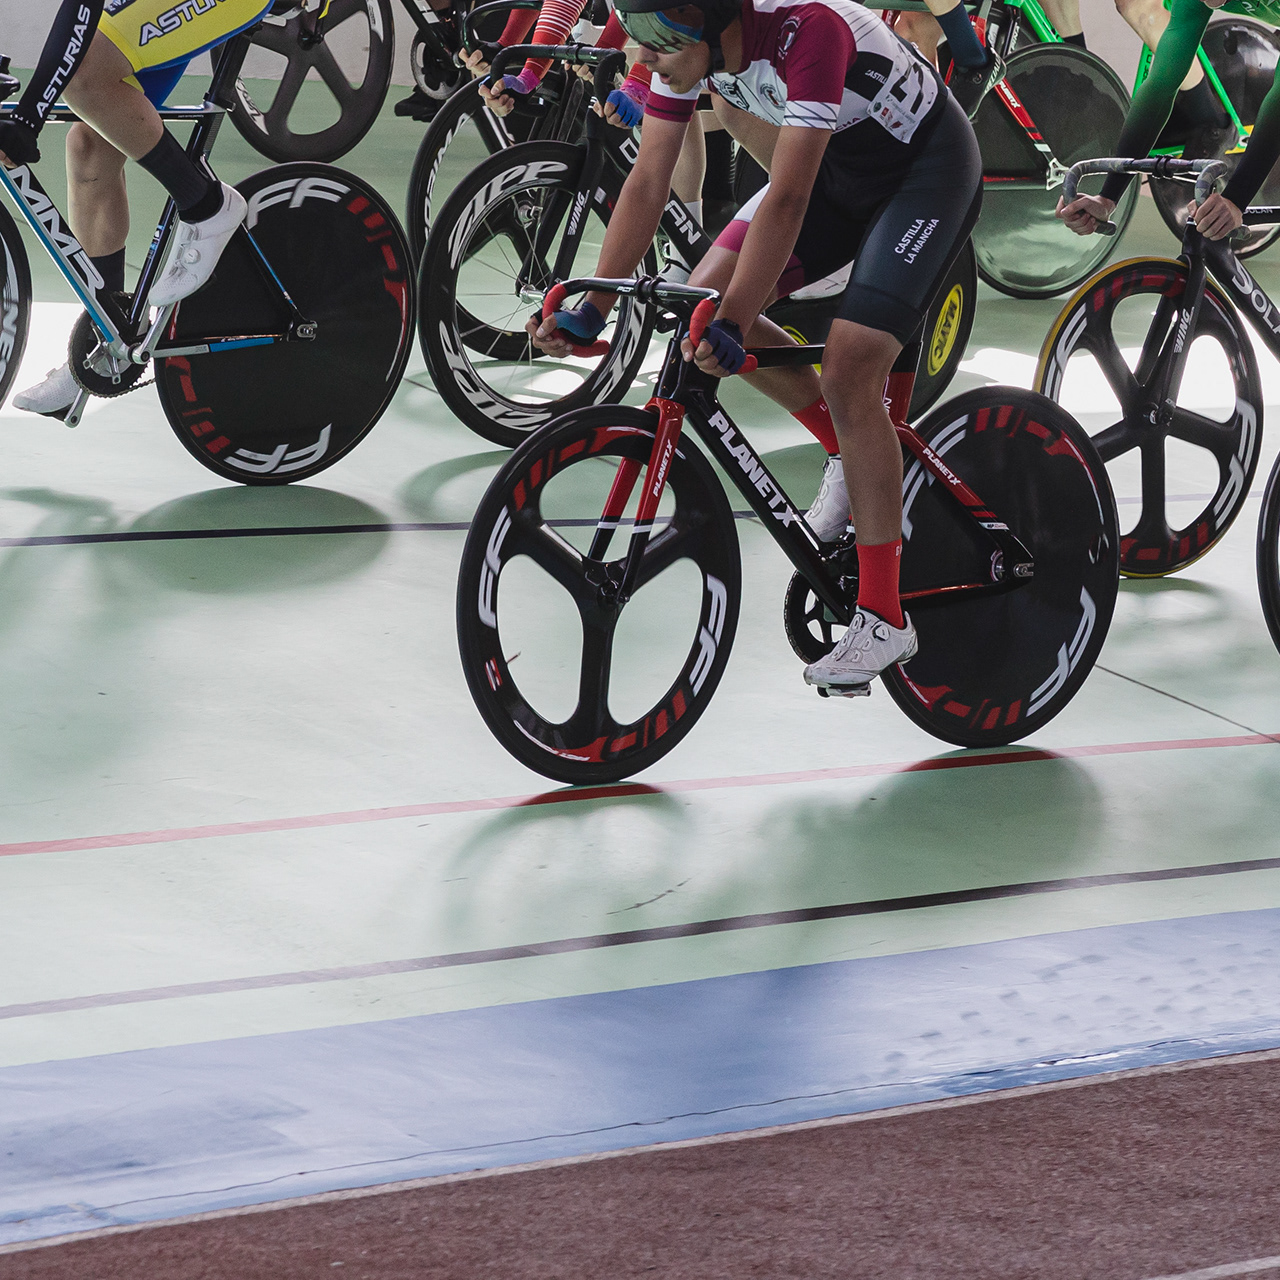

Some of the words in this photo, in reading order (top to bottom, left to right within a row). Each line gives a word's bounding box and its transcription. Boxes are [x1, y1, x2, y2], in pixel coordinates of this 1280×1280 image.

[35, 4, 91, 119] ASTURIAS
[894, 218, 926, 256] CASTILLA
[904, 251, 918, 265] LA
[912, 218, 940, 257] MANCHA
[933, 298, 958, 360] MAVIC
